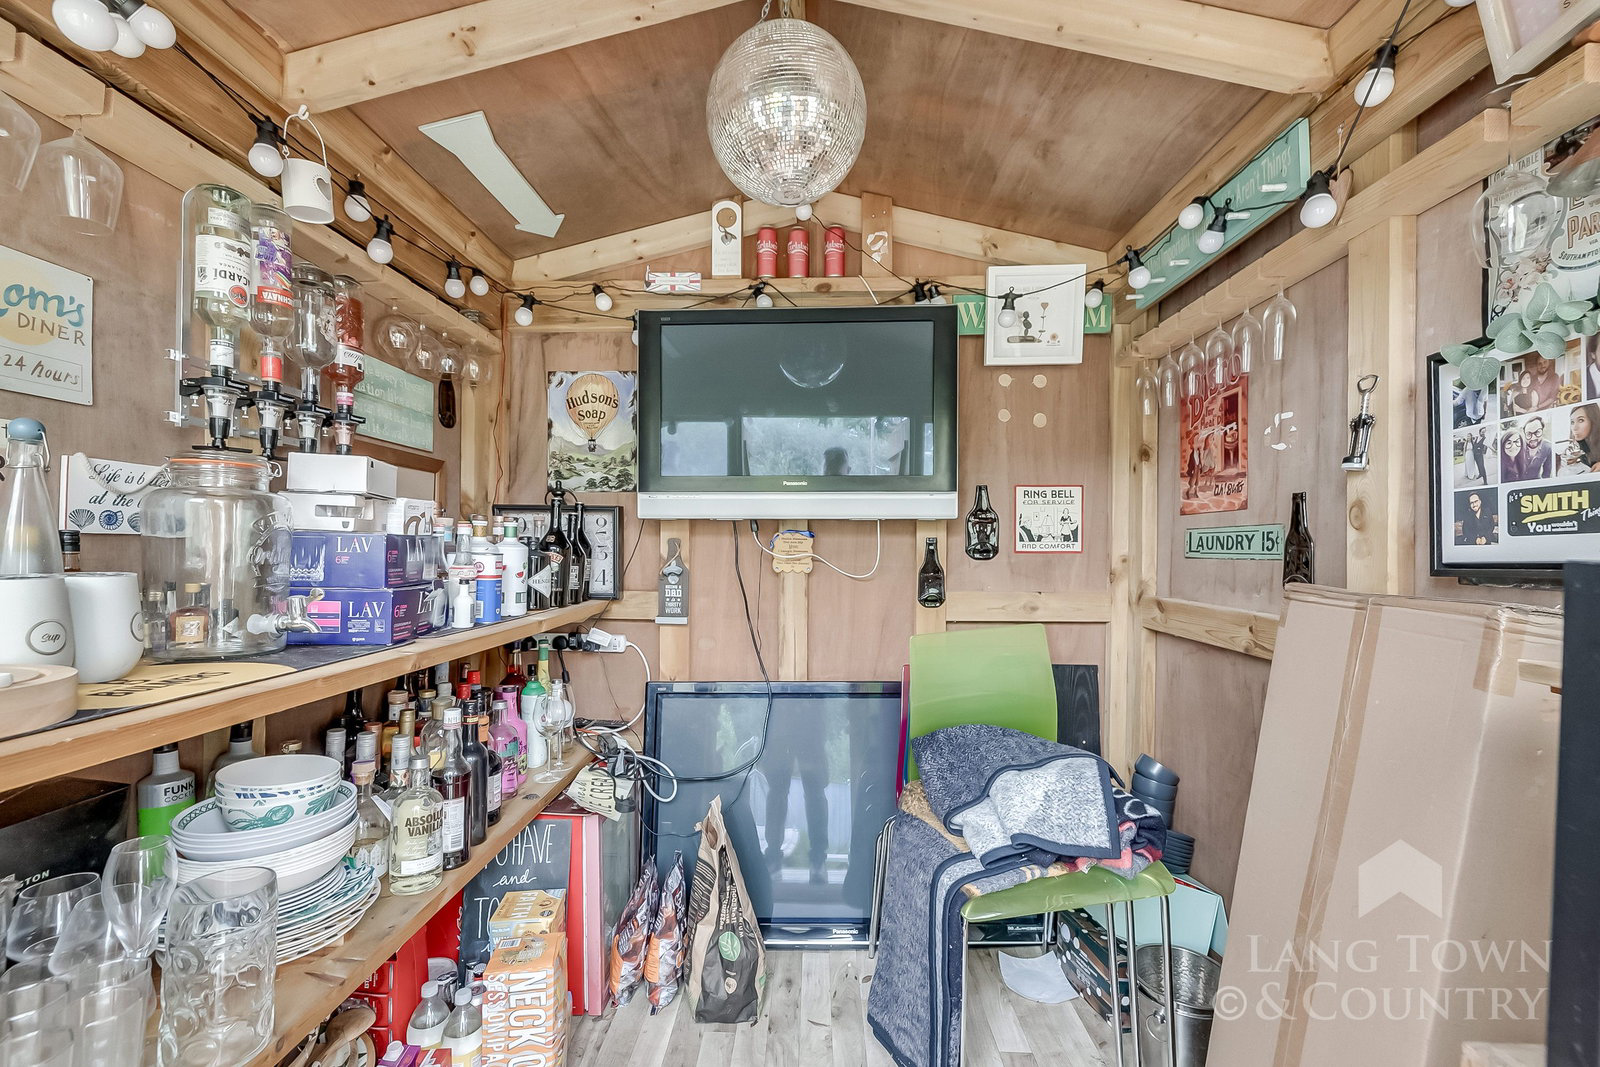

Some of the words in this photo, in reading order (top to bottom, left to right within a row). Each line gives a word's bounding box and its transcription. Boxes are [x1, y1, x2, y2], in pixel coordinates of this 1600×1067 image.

[1261, 145, 1292, 178] Things
[1518, 153, 1540, 170] TABLE
[1567, 211, 1600, 250] PAR
[1558, 246, 1600, 261] SOUTHAMPTO
[213, 268, 250, 286] CARDÍ
[0, 284, 85, 327] om's
[17, 312, 86, 346] DINER
[3, 354, 27, 372] 24
[30, 360, 80, 385] hours
[566, 390, 619, 410] Hudson's
[578, 409, 606, 421] Soap
[124, 472, 135, 484] is
[89, 491, 108, 504] at
[113, 494, 134, 507] the
[1023, 490, 1047, 498] RING
[1051, 490, 1074, 498] BELL
[1520, 490, 1590, 513] SMITH
[1527, 522, 1552, 533] You
[336, 536, 373, 553] LAV
[1188, 531, 1256, 553] LAUNDRY
[594, 569, 609, 586] 4
[347, 601, 385, 618] LAV
[164, 780, 194, 797] FUNK
[405, 807, 443, 828] ABSOLU
[512, 824, 556, 866] HAVE
[492, 869, 537, 887] and
[511, 891, 539, 919] FAITH
[487, 973, 506, 1033] SESSION
[508, 970, 548, 1051] NECK
